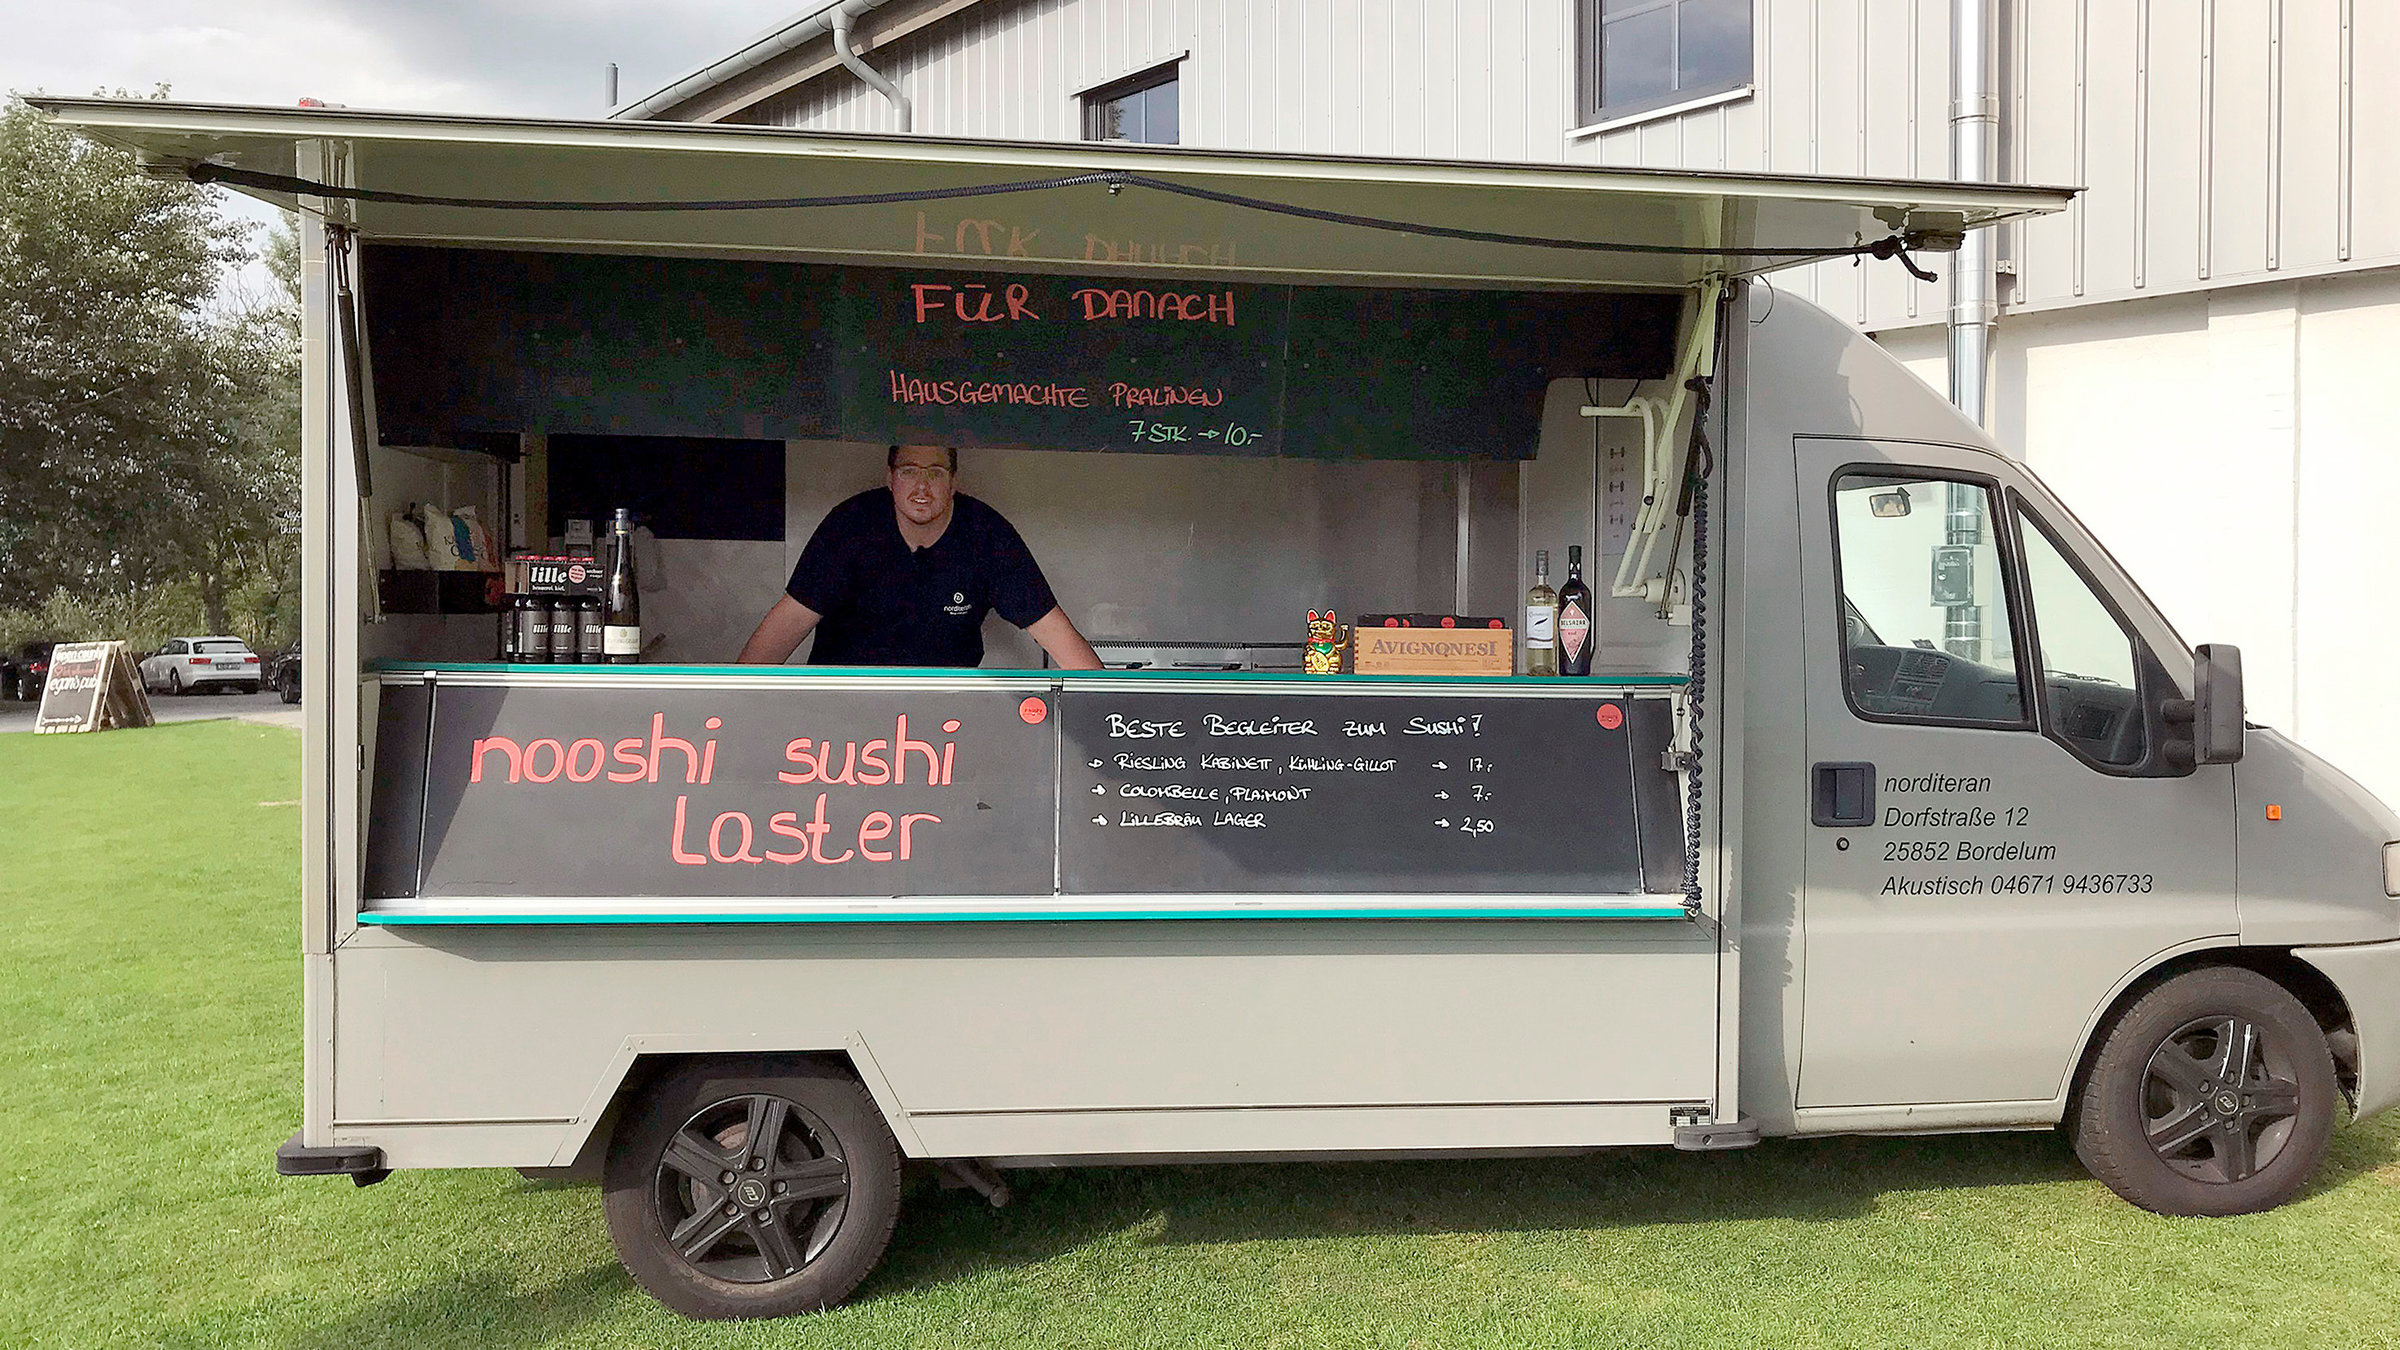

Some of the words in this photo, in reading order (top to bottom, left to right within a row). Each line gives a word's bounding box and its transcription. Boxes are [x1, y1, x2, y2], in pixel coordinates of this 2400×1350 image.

[910, 283, 1041, 324] FÜR
[1071, 288, 1235, 326] DANACH
[889, 369, 1091, 408] HAUSGEMACHTE
[1107, 381, 1224, 409] PRALINEN
[1129, 420, 1146, 442] 7
[530, 566, 568, 584] lille
[553, 624, 572, 634] lille
[1371, 639, 1498, 657] AVIGNONESI
[1105, 713, 1186, 738] BESTE
[1202, 713, 1319, 737] BEGLEITER
[470, 712, 722, 783] nooshi
[778, 713, 962, 785] sushi
[1113, 752, 1186, 771] RIESLING
[1883, 773, 1991, 792] norditeran
[1213, 811, 1267, 828] LAGER
[1460, 816, 1495, 838] 2,50
[1884, 807, 1996, 827] Dorfstraße
[2005, 807, 2029, 827] 12
[671, 793, 942, 864] Laster
[1883, 842, 1949, 861] 25852
[1956, 841, 2056, 861] Bordelum
[1881, 875, 1984, 896] Akustisch
[1991, 875, 2055, 895] 04671
[2063, 875, 2153, 894] 9436733
